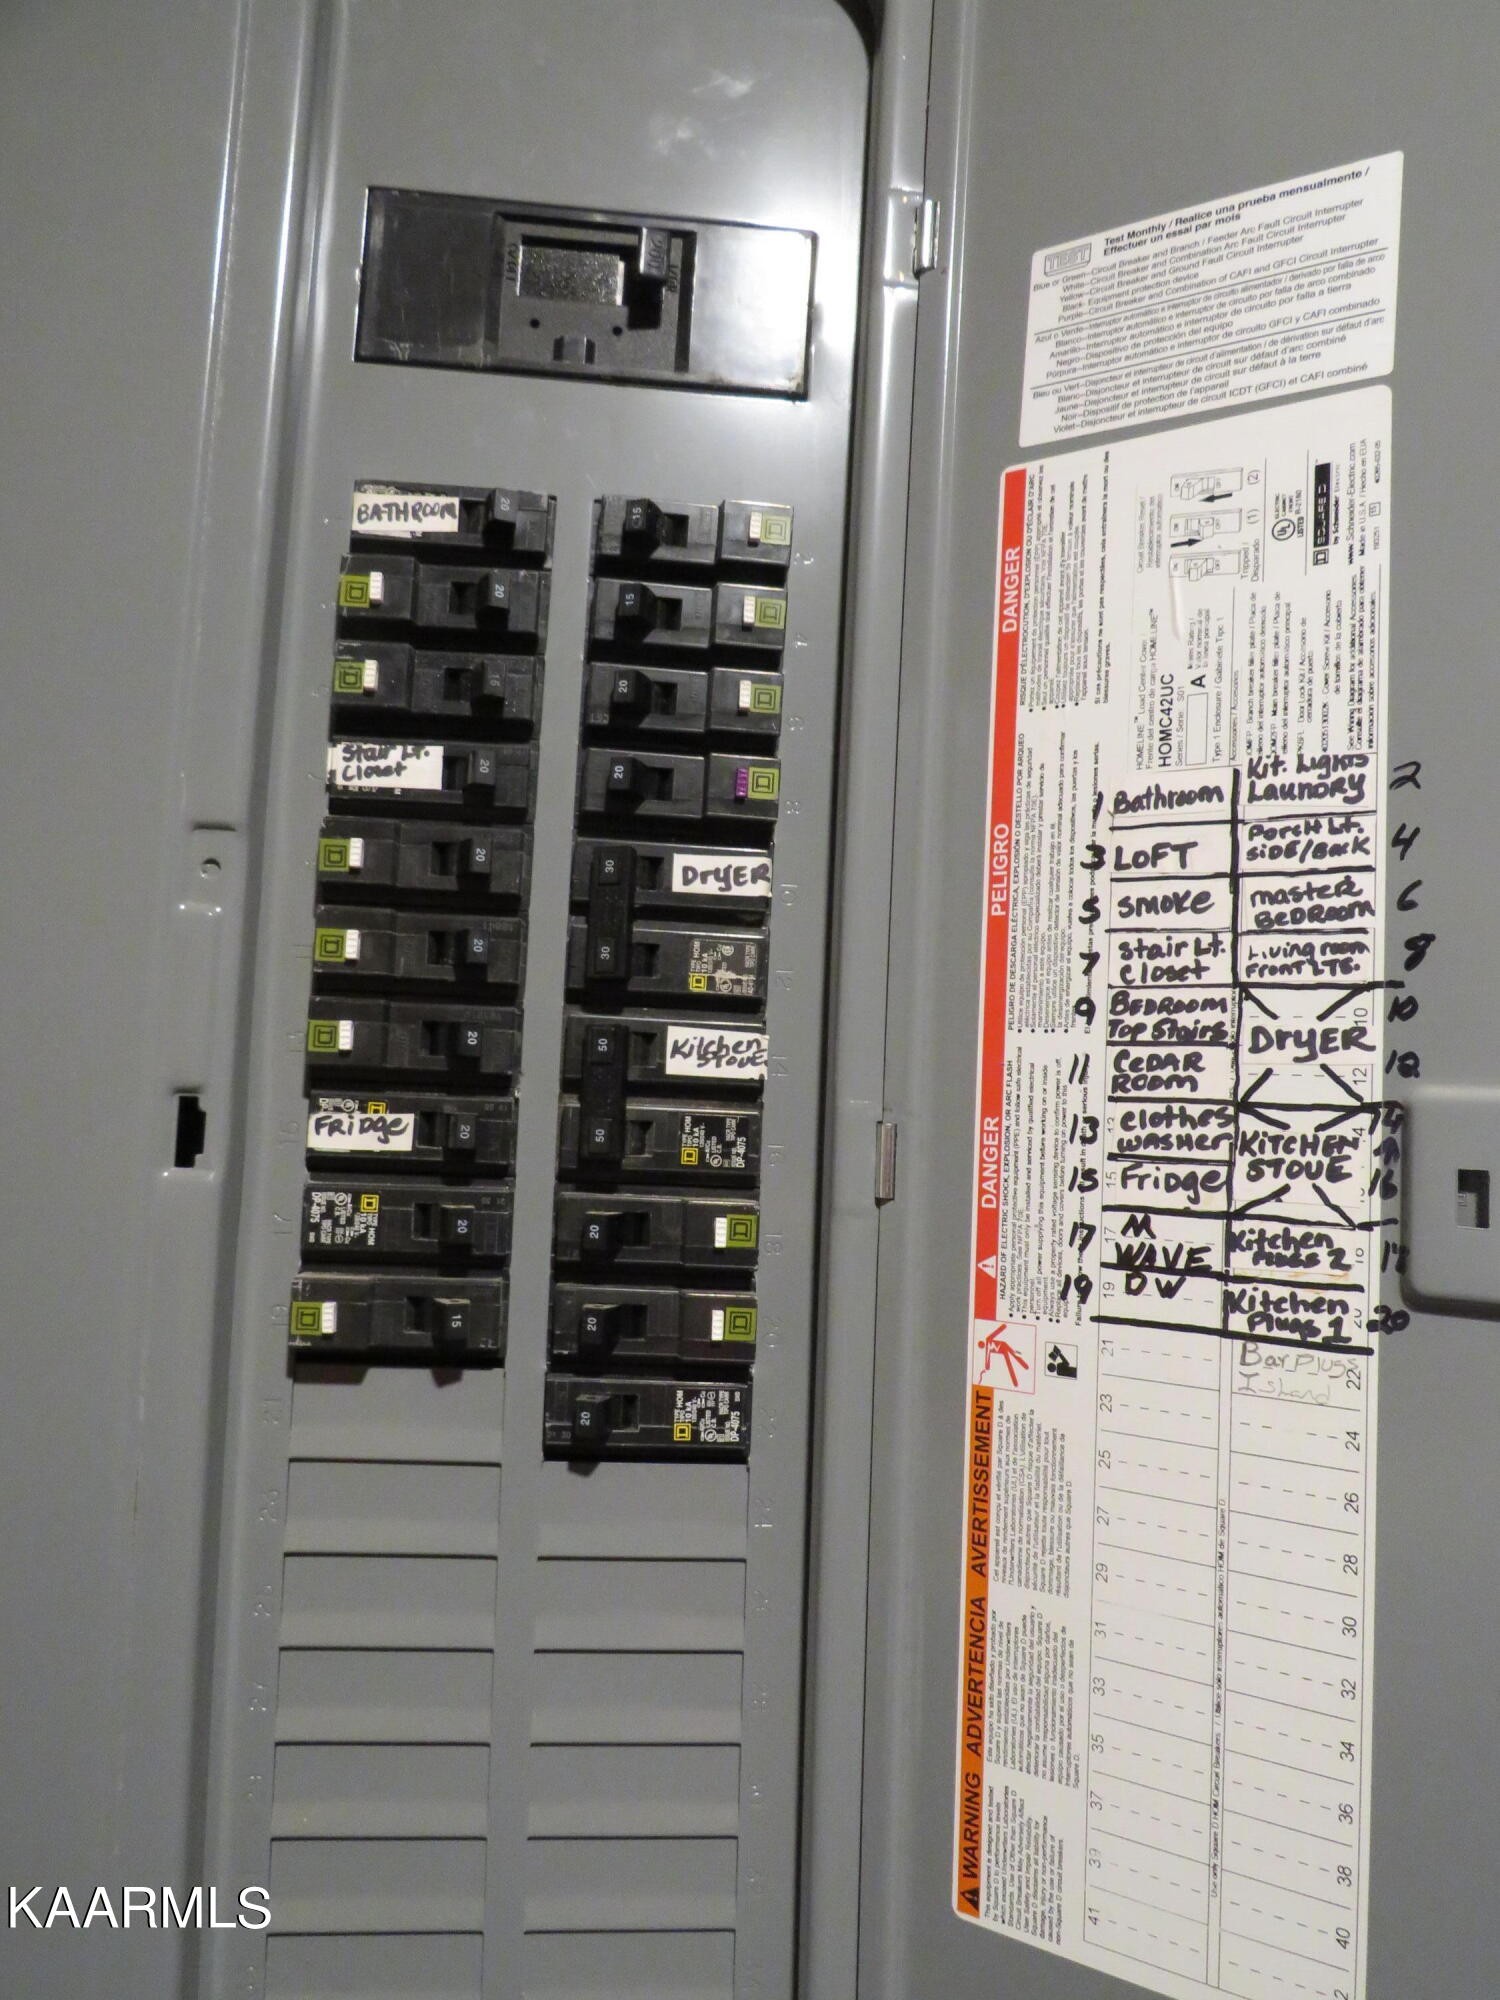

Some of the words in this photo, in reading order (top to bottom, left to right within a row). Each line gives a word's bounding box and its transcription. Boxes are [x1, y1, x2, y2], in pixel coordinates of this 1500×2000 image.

[1104, 234, 1125, 246] Test
[1127, 223, 1166, 240] Monthly
[1174, 211, 1212, 226] Realice
[1215, 204, 1235, 215] una
[1237, 193, 1276, 211] prueba
[1279, 171, 1363, 198] mensualmente
[1103, 238, 1148, 256] Effectuer
[1150, 233, 1163, 243] un
[1165, 226, 1192, 239] essai
[1195, 221, 1212, 233] par
[1215, 214, 1241, 225] mois
[357, 503, 458, 525] BATHROOM
[494, 584, 505, 598] 20
[626, 593, 635, 607] 15
[1002, 546, 1021, 633] DANGER
[618, 679, 629, 693] 20
[1190, 675, 1206, 689] A
[1158, 672, 1175, 768] HOMC42UC
[479, 759, 490, 774] 20
[613, 764, 624, 779] 20
[1389, 761, 1421, 790] 2
[1113, 783, 1224, 814] Bathroom
[1391, 823, 1421, 861] 4
[475, 847, 487, 863] 20
[605, 858, 615, 874] 30
[1079, 844, 1107, 870] 3
[1114, 841, 1198, 871] LOFT
[991, 823, 1010, 917] PELIGRO
[1396, 879, 1422, 911] 6
[1078, 895, 1101, 924] 5
[473, 938, 484, 953] 20
[600, 945, 611, 960] 30
[1079, 951, 1100, 976] 7
[1074, 996, 1097, 1026] 9
[1353, 1007, 1368, 1028] 10
[1388, 995, 1419, 1023] 10
[467, 1030, 478, 1046] 20
[598, 1037, 608, 1052] 50
[1005, 1060, 1013, 1087] FLASH
[1068, 1053, 1090, 1085] 11
[1352, 1067, 1367, 1085] 12
[1004, 1109, 1011, 1121] OR
[459, 1124, 471, 1140] 20
[595, 1128, 605, 1143] 50
[1069, 1113, 1100, 1145] 13
[736, 1137, 746, 1168] DP-4075
[981, 1115, 1000, 1209] DANGER
[1068, 1166, 1099, 1193] 15
[310, 1191, 321, 1223] DP-4075
[457, 1219, 468, 1234] 20
[589, 1224, 600, 1240] 20
[1001, 1209, 1009, 1250] ELECTRIC
[1068, 1221, 1096, 1252] 17
[1104, 1227, 1116, 1244] 17
[1121, 1212, 1157, 1239] M
[1230, 1227, 1334, 1253] Kitchen
[1000, 1252, 1007, 1263] OF
[1115, 1242, 1213, 1272] WAVE
[1327, 1248, 1352, 1271] 2
[999, 1265, 1007, 1300] HAZARD
[1060, 1274, 1093, 1304] 19
[1103, 1281, 1115, 1298] 19
[1228, 1288, 1350, 1315] Kitchen
[451, 1313, 462, 1328] 15
[587, 1316, 597, 1331] 20
[1322, 1316, 1352, 1343] 1
[1101, 1339, 1114, 1357] 21
[1239, 1341, 1288, 1369] Bar
[1346, 1369, 1361, 1390] 22
[1100, 1393, 1113, 1413] 23
[580, 1411, 591, 1426] 20
[730, 1410, 740, 1441] DP-4075
[1345, 1431, 1360, 1452] 24
[1098, 1449, 1111, 1469] 25
[971, 1390, 992, 1578] AVERTISSEMENT
[1344, 1492, 1360, 1514] 26
[1096, 1506, 1109, 1526] 27
[1095, 1562, 1108, 1583] 29
[1343, 1554, 1358, 1576] 28
[1094, 1621, 1107, 1638] 31
[1342, 1616, 1357, 1638] 30
[966, 1596, 986, 1758] ADVERTENCIA
[1093, 1676, 1105, 1696] 33
[1341, 1678, 1357, 1700] 32
[1091, 1733, 1105, 1754] 35
[1340, 1741, 1355, 1762] 34
[1089, 1790, 1103, 1811] 37
[1338, 1803, 1354, 1825] 36
[963, 1772, 981, 1880] WARNING
[1088, 1849, 1101, 1868] 39
[1337, 1865, 1352, 1887] 38
[1087, 1906, 1100, 1926] 41
[1335, 1927, 1351, 1950] 40
